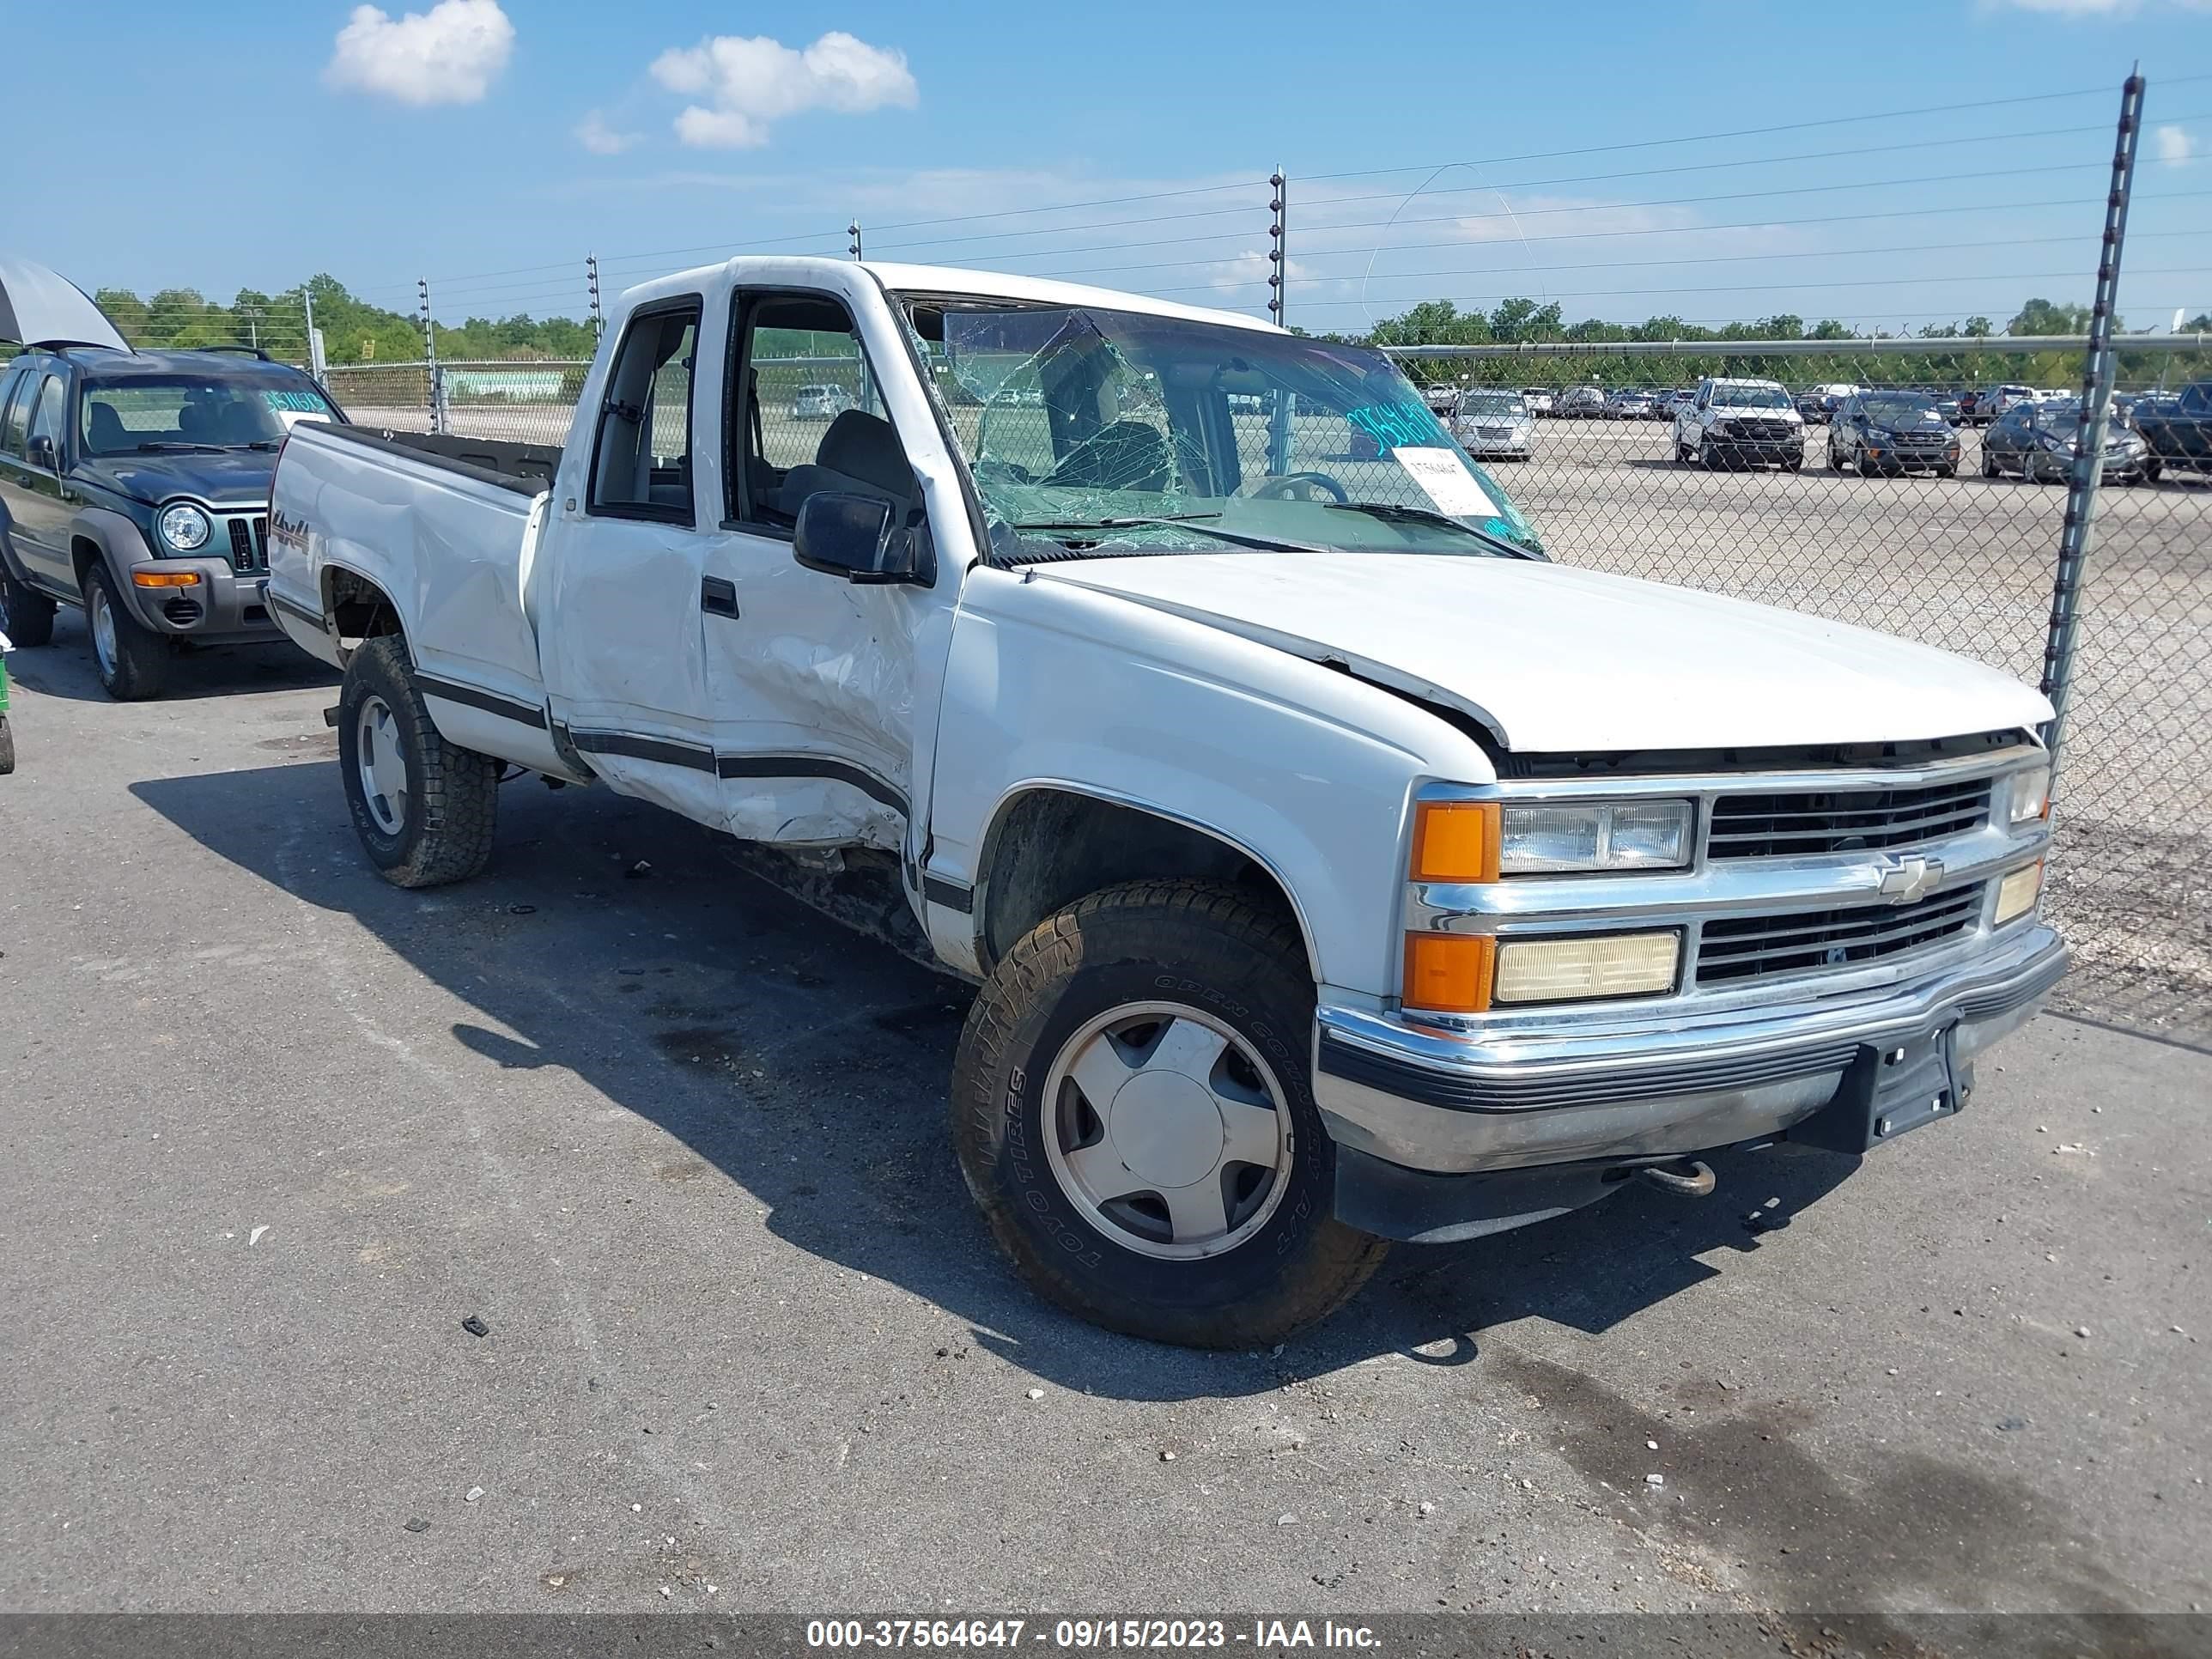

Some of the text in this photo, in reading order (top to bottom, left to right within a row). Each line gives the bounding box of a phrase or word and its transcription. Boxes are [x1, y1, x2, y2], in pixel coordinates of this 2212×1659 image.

[1154, 975, 1249, 1018] OPEN
[1006, 1065, 1102, 1268] TOYO TIRES
